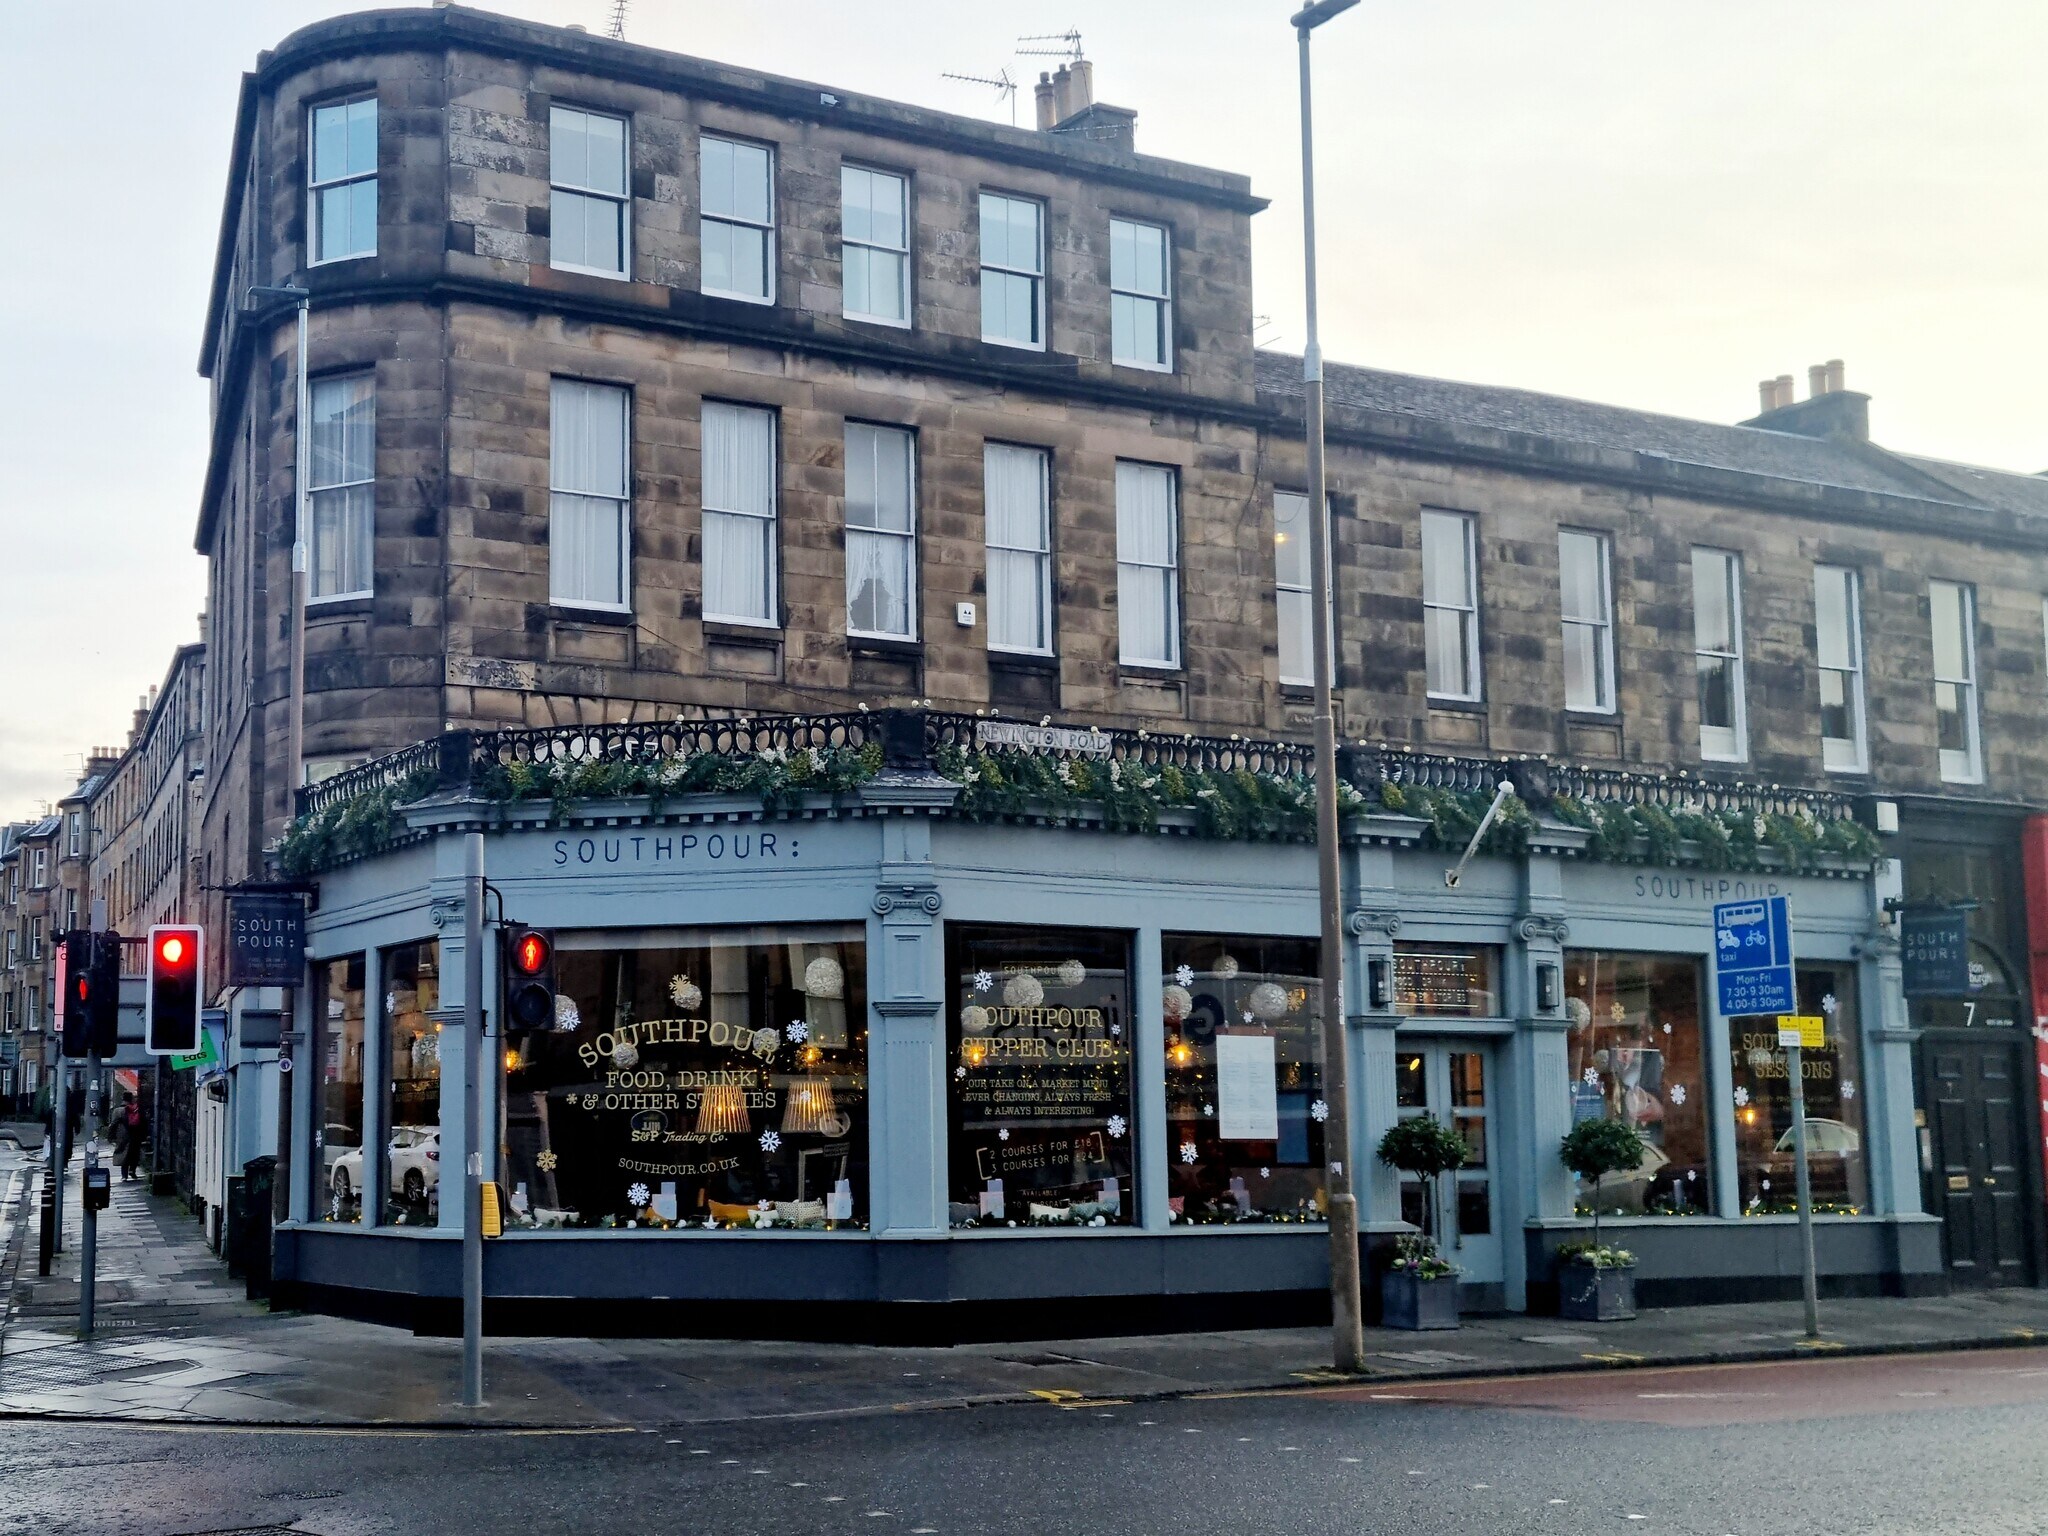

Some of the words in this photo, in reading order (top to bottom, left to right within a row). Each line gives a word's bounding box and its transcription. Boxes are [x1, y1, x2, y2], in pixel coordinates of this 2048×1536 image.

[979, 724, 1063, 747] NEWINGTON
[1069, 734, 1108, 750] ROAD
[554, 833, 798, 864] SOUTHPOUR:
[238, 919, 296, 931] SOUTH
[237, 935, 295, 948] POUR:
[1907, 931, 1959, 946] SOUTH
[1720, 951, 1737, 962] taxi
[1736, 973, 1771, 985] Mon-Fri
[1963, 1002, 1975, 1027] 7
[577, 1018, 778, 1069] SOUTHPOUR
[961, 1037, 1048, 1058] SUPPER
[1056, 1038, 1113, 1058] CLUB
[1755, 1060, 1832, 1079] SESSONS
[605, 1071, 671, 1091] FOOD,
[677, 1070, 756, 1089] DRINK
[968, 1079, 987, 1089] OUR
[989, 1079, 1015, 1089] TAKE
[1041, 1079, 1080, 1088] MARKET
[582, 1093, 599, 1110] &
[605, 1093, 680, 1110] OTHER
[1045, 1092, 1081, 1101] ALWAYS
[984, 1106, 993, 1116] &
[995, 1106, 1032, 1115] ALWAYS
[1034, 1106, 1095, 1115] INTERESTING!
[631, 1129, 660, 1142] S&P
[662, 1130, 708, 1144] Trading
[710, 1128, 728, 1143] Co.
[989, 1150, 996, 1160] 2
[1001, 1143, 1045, 1158] COURSES
[1050, 1140, 1069, 1152] FOR
[618, 1156, 740, 1175] SOUTHPOUR.CO.UK
[1003, 1157, 1046, 1173] COURSES
[1051, 1154, 1070, 1166] FOR
